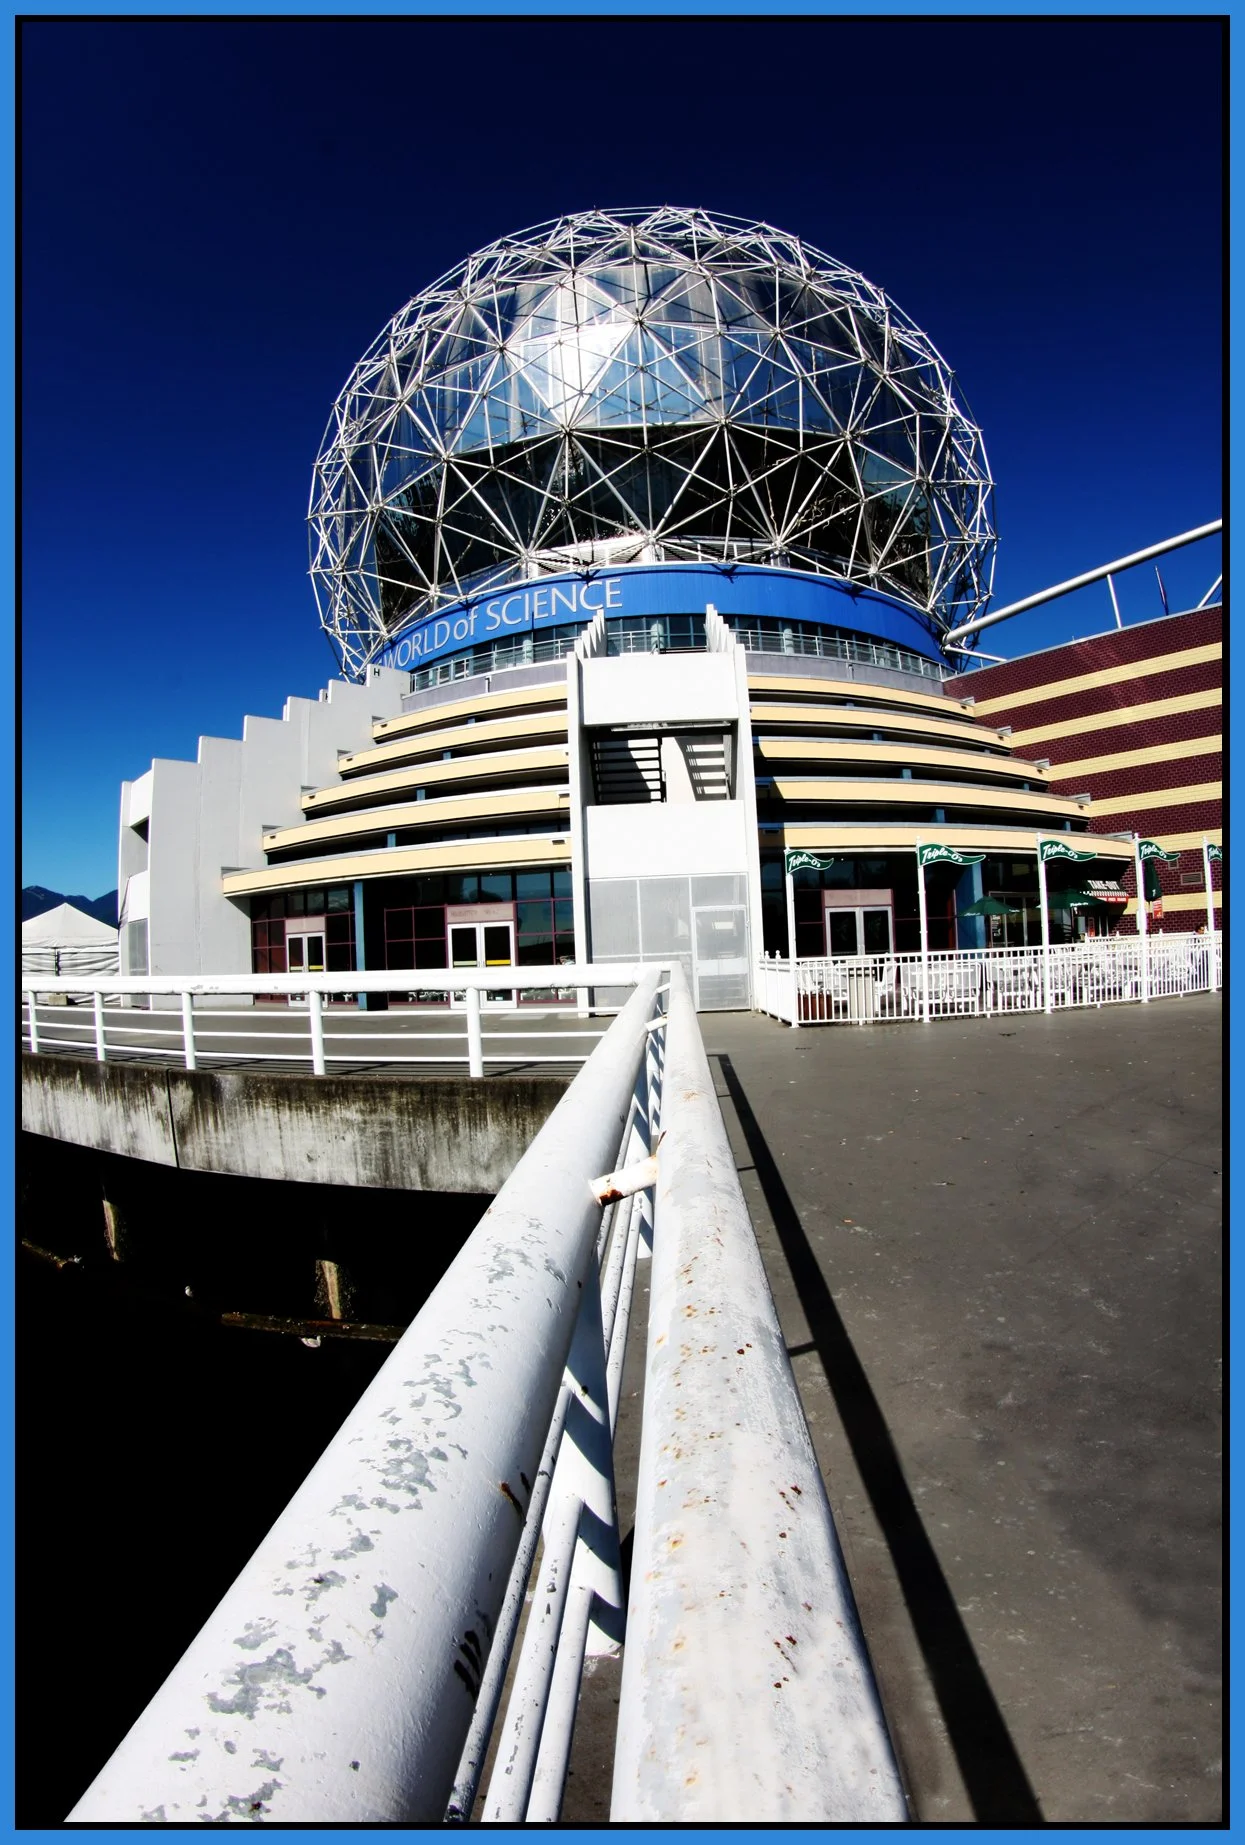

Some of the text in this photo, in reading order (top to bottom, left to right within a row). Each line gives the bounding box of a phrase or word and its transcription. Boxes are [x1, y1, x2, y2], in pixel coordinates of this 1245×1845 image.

[384, 578, 623, 669] WORLD of SCIENCE
[373, 667, 381, 677] H
